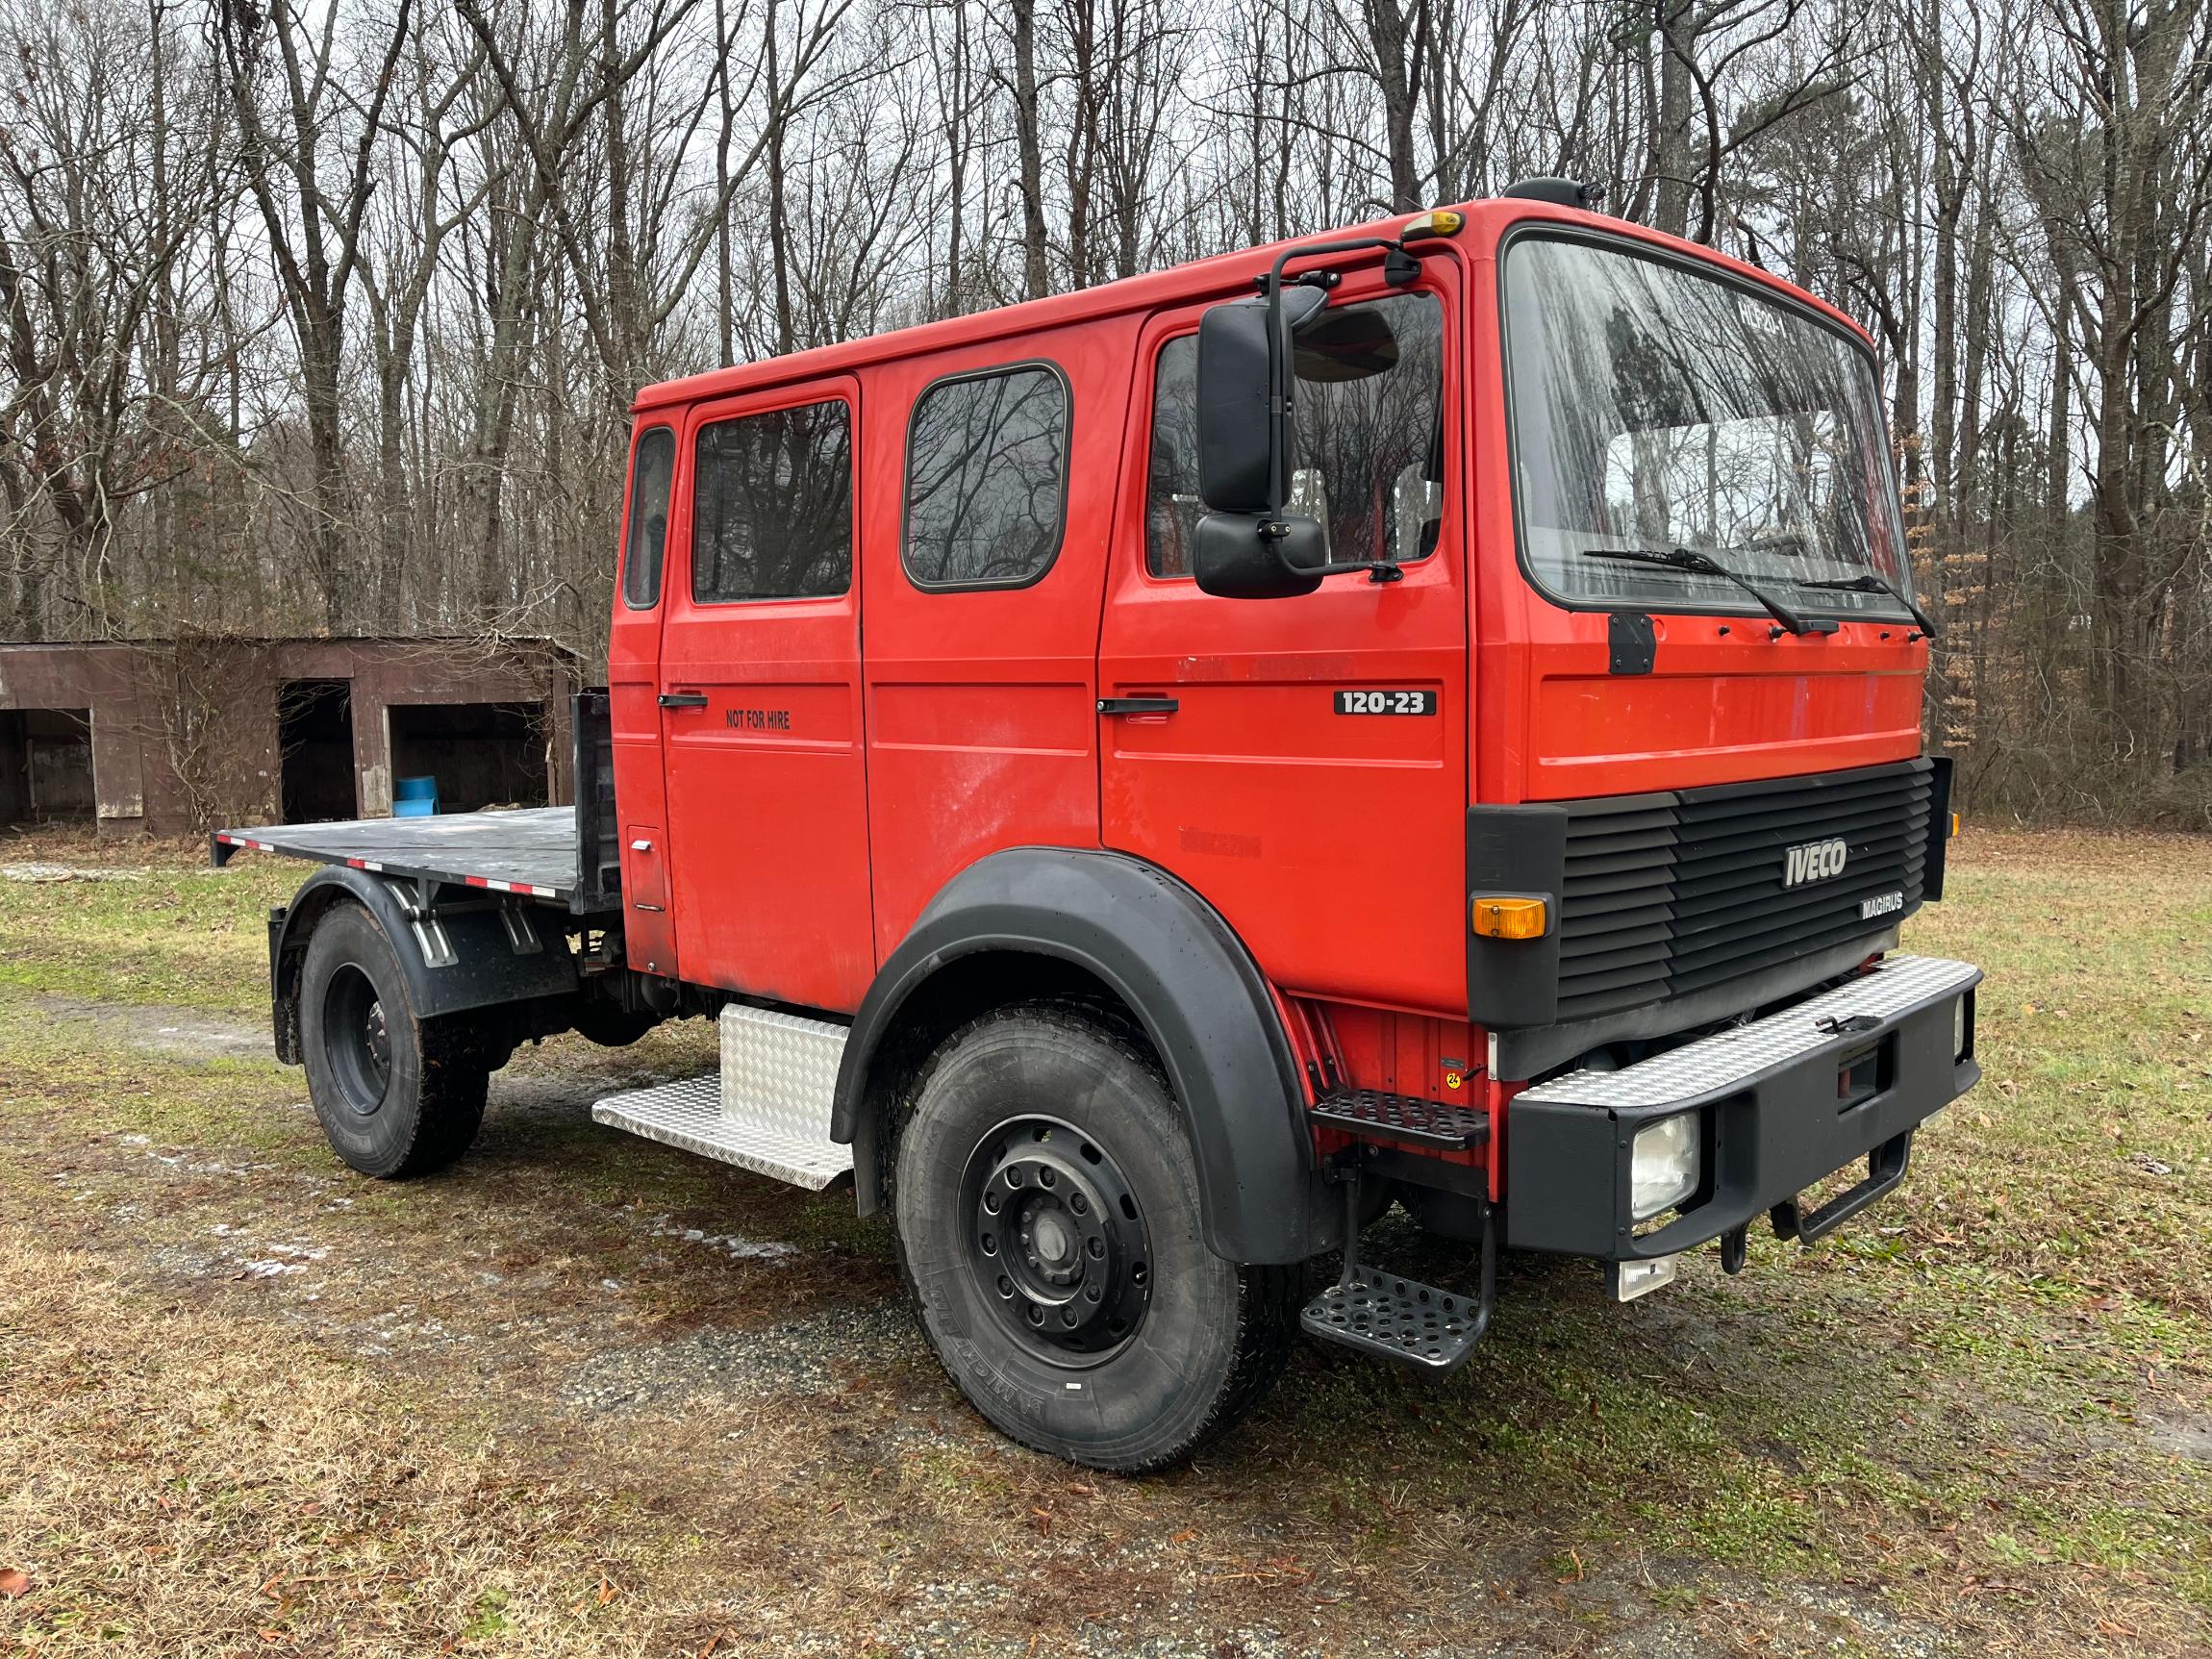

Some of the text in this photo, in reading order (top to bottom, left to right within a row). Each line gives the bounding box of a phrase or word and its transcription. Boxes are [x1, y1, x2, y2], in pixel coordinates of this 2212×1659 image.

[1343, 691, 1424, 713] 120-23
[726, 710, 791, 730] NOT FOR HIRE
[1786, 839, 1847, 886] IVECO
[1862, 892, 1903, 919] MAGIRUS
[1448, 1074, 1458, 1084] 24
[928, 1287, 1019, 1403] MICHELIN
